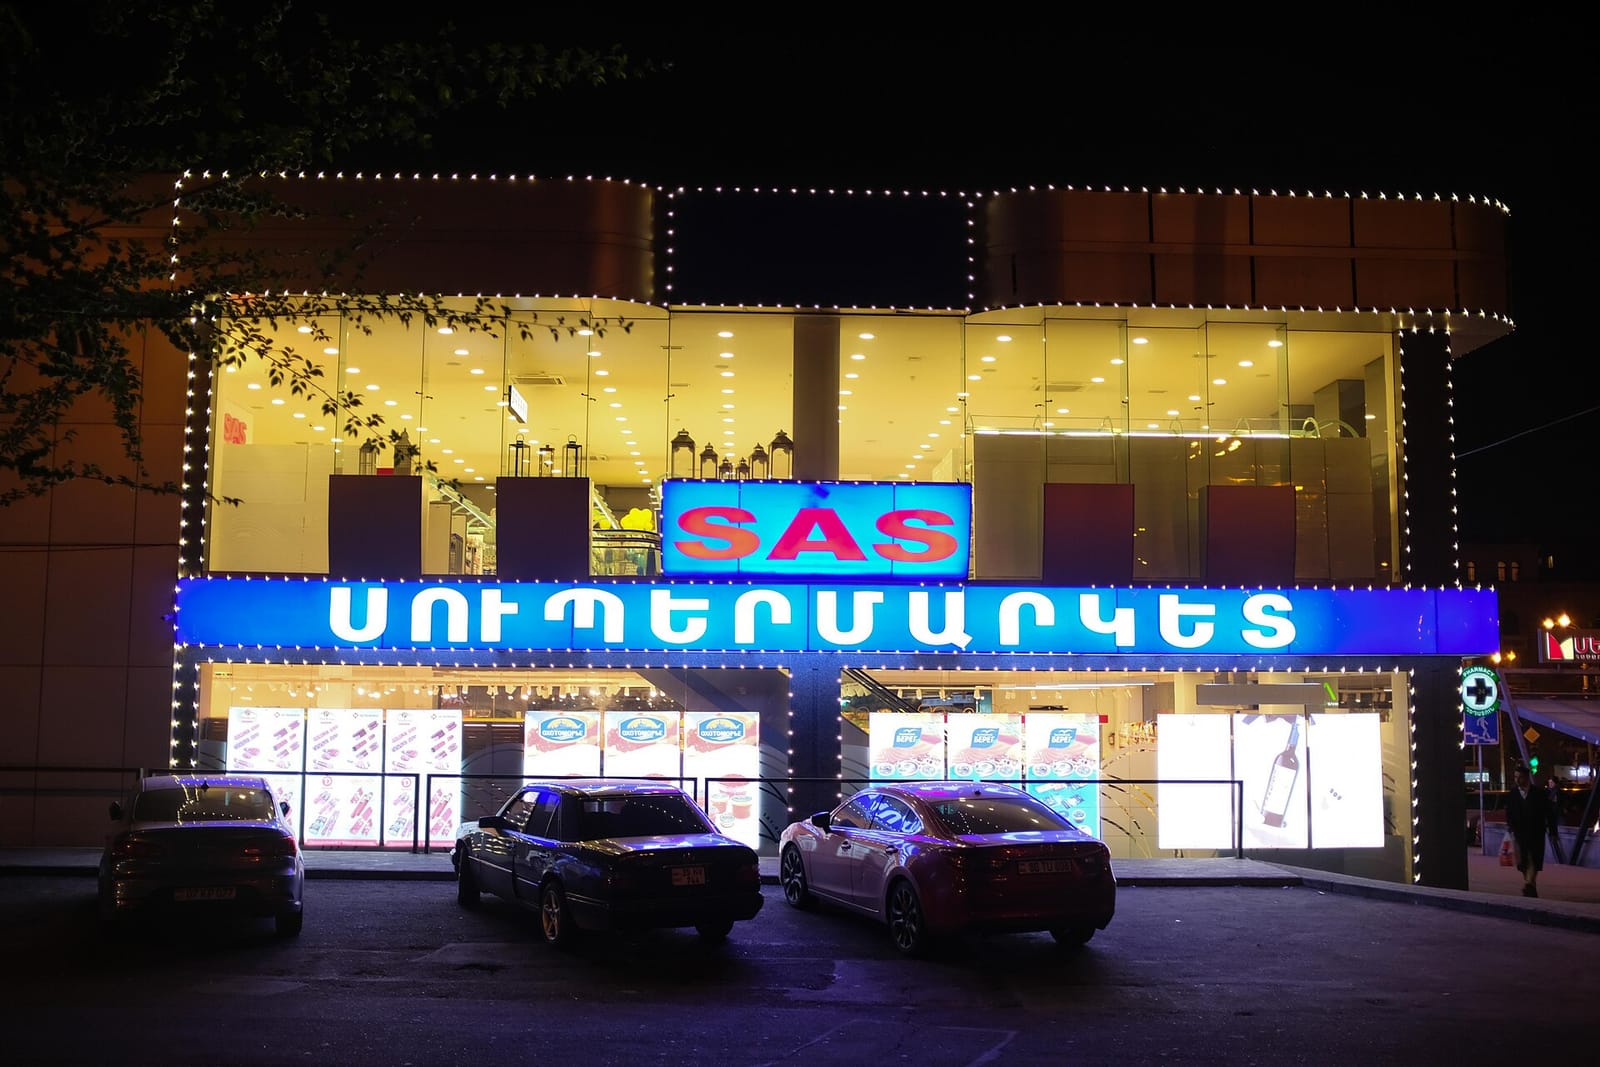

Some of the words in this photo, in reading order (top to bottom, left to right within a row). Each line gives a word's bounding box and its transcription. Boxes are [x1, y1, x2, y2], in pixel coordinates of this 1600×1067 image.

[674, 506, 958, 563] SAS
[329, 586, 1297, 650] ՍՈՒՊԵՐՄԱՐԿԵՏ
[1462, 666, 1495, 677] PHARMACY
